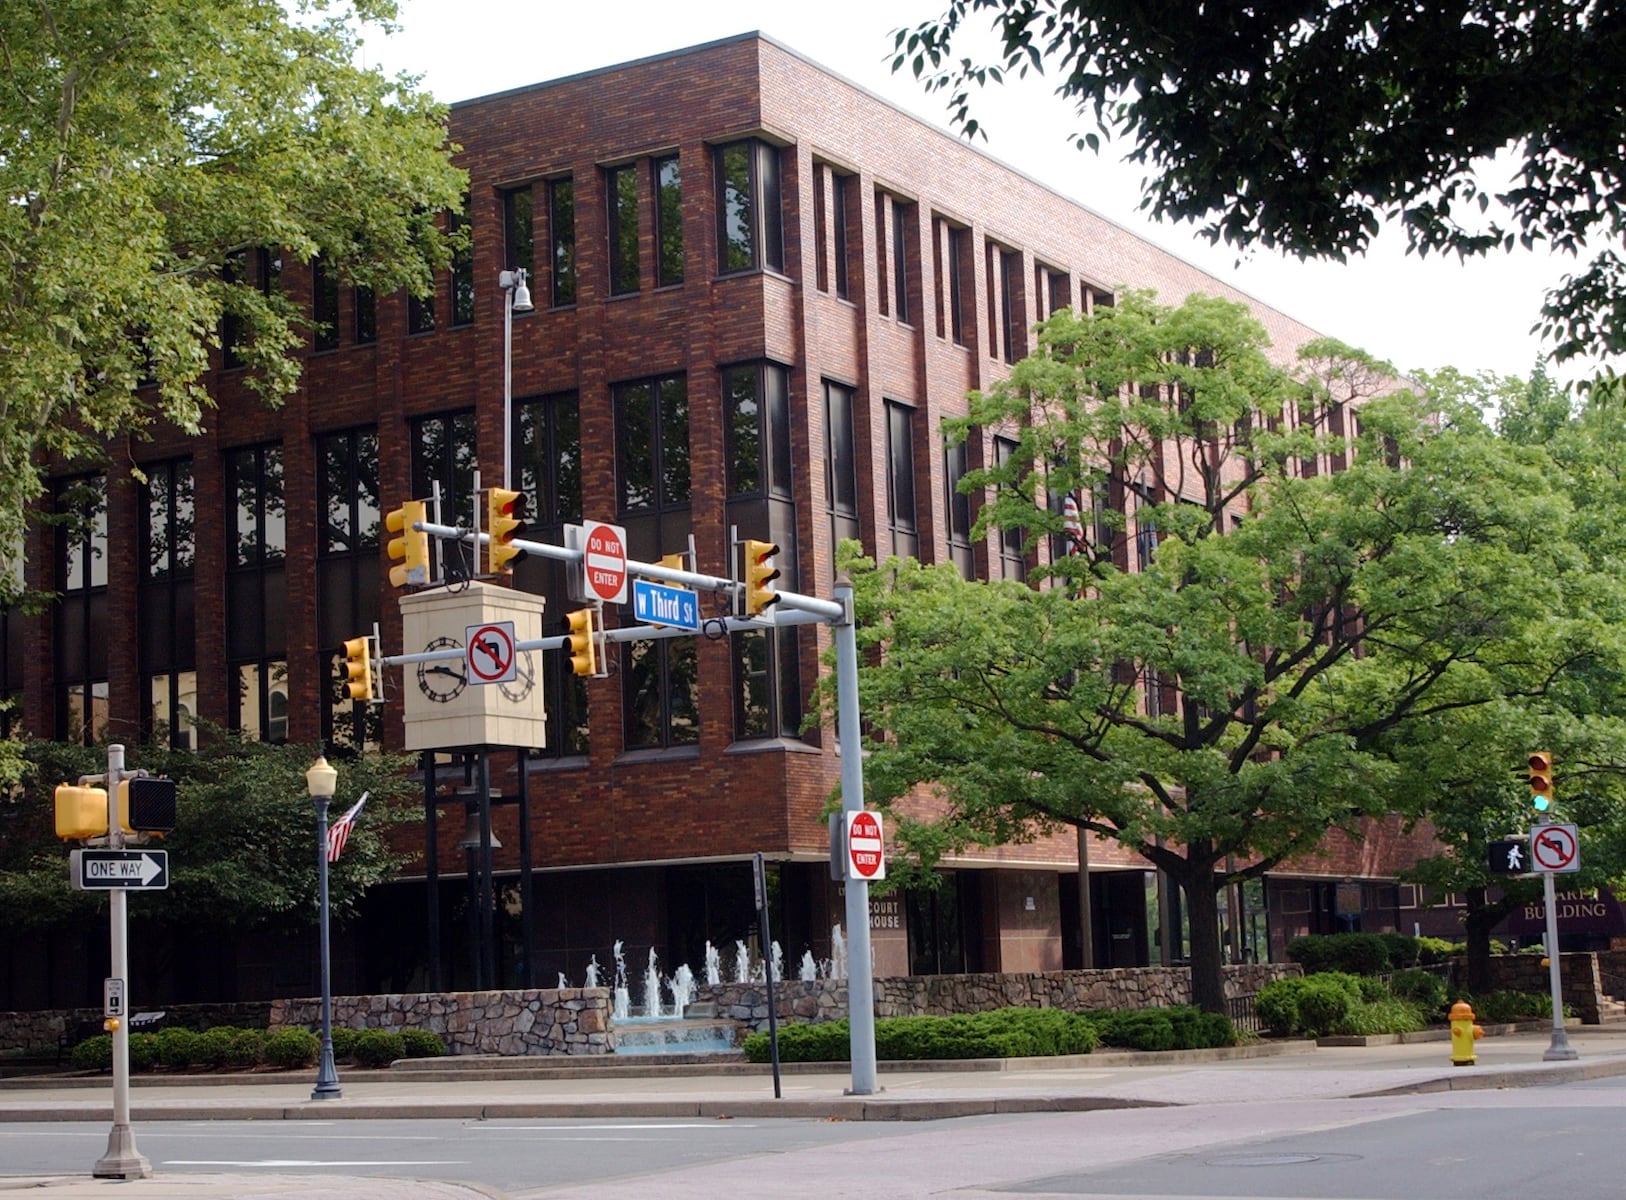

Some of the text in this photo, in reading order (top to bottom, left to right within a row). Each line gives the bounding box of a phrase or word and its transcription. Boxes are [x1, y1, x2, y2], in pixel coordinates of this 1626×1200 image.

[590, 537, 620, 554] DO NOT
[593, 571, 618, 587] ENTER
[637, 589, 694, 624] W Third St
[852, 824, 877, 836] DO NOT
[856, 853, 877, 865] ENTER
[91, 862, 142, 876] ONE WAY
[868, 901, 899, 914] COURT
